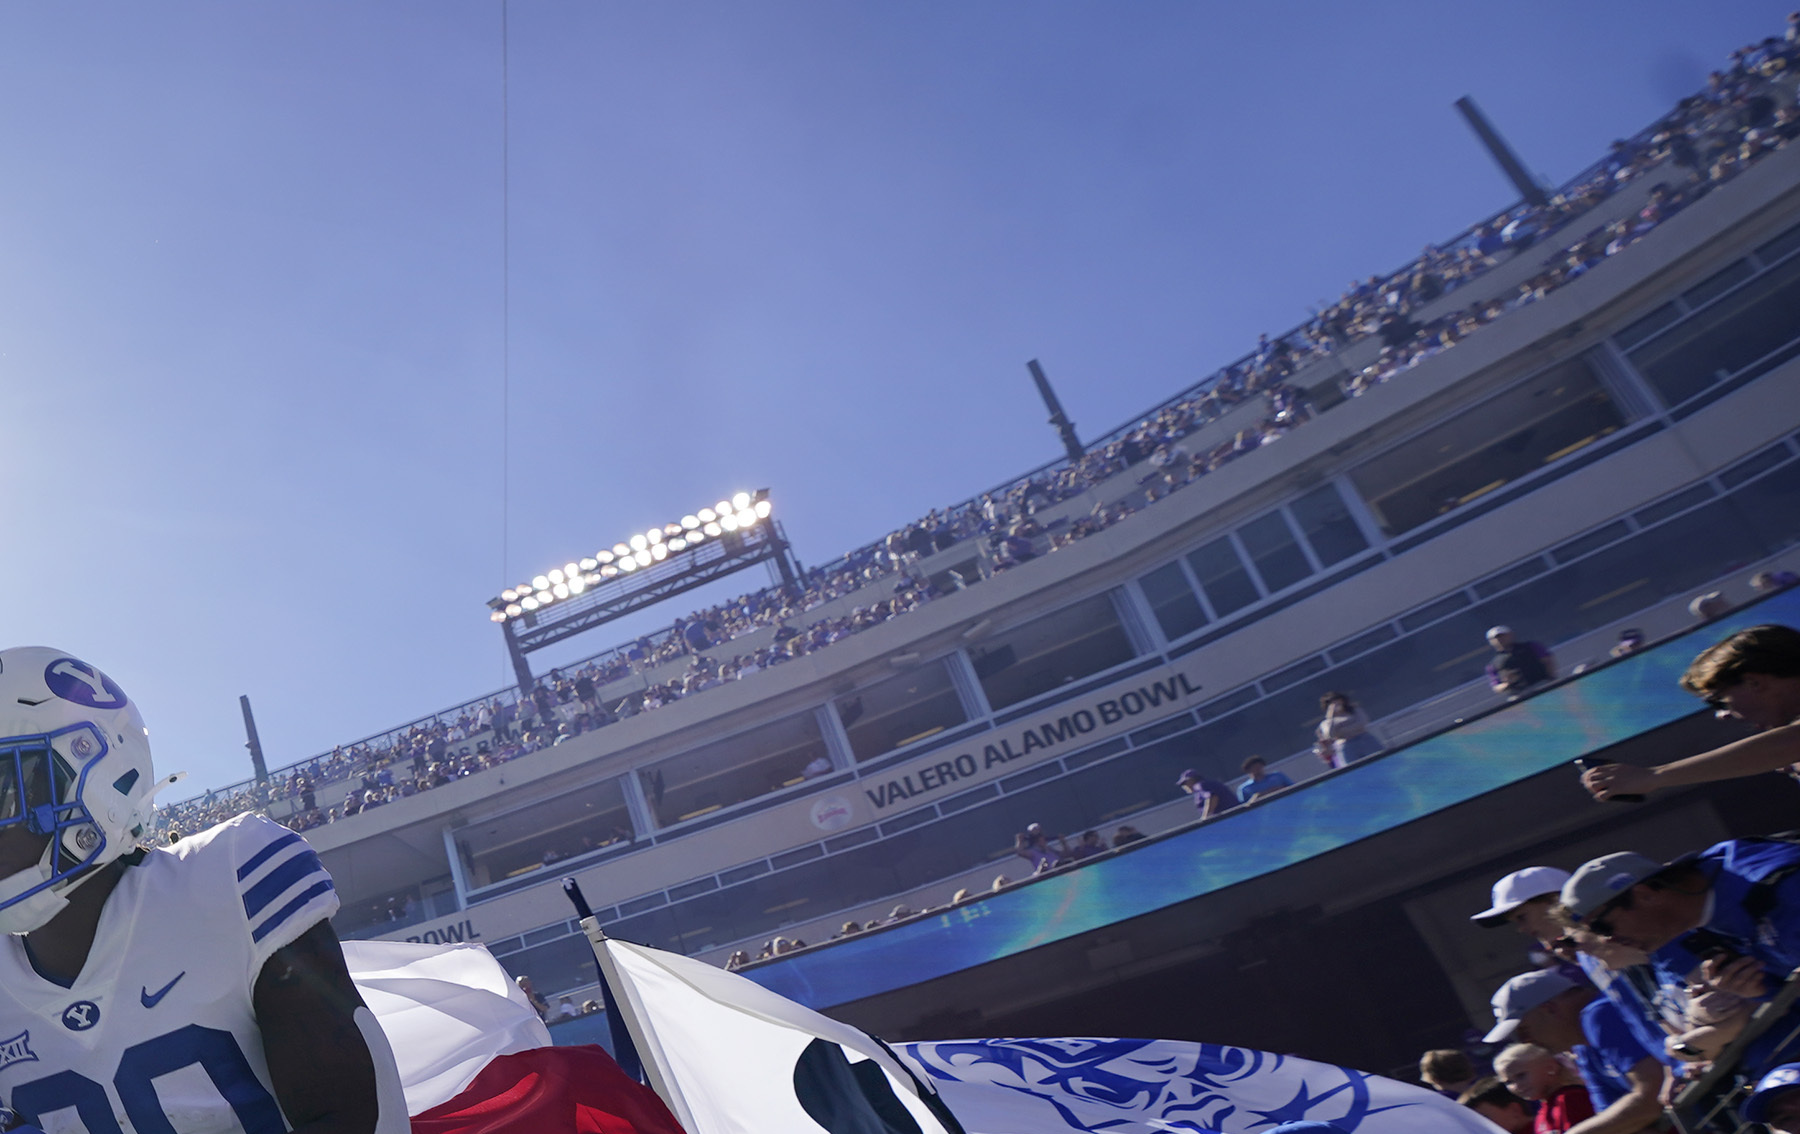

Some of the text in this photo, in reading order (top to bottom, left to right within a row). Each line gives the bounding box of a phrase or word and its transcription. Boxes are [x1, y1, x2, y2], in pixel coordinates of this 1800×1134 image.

[865, 672, 1202, 810] VALERO ALAMO BOWL
